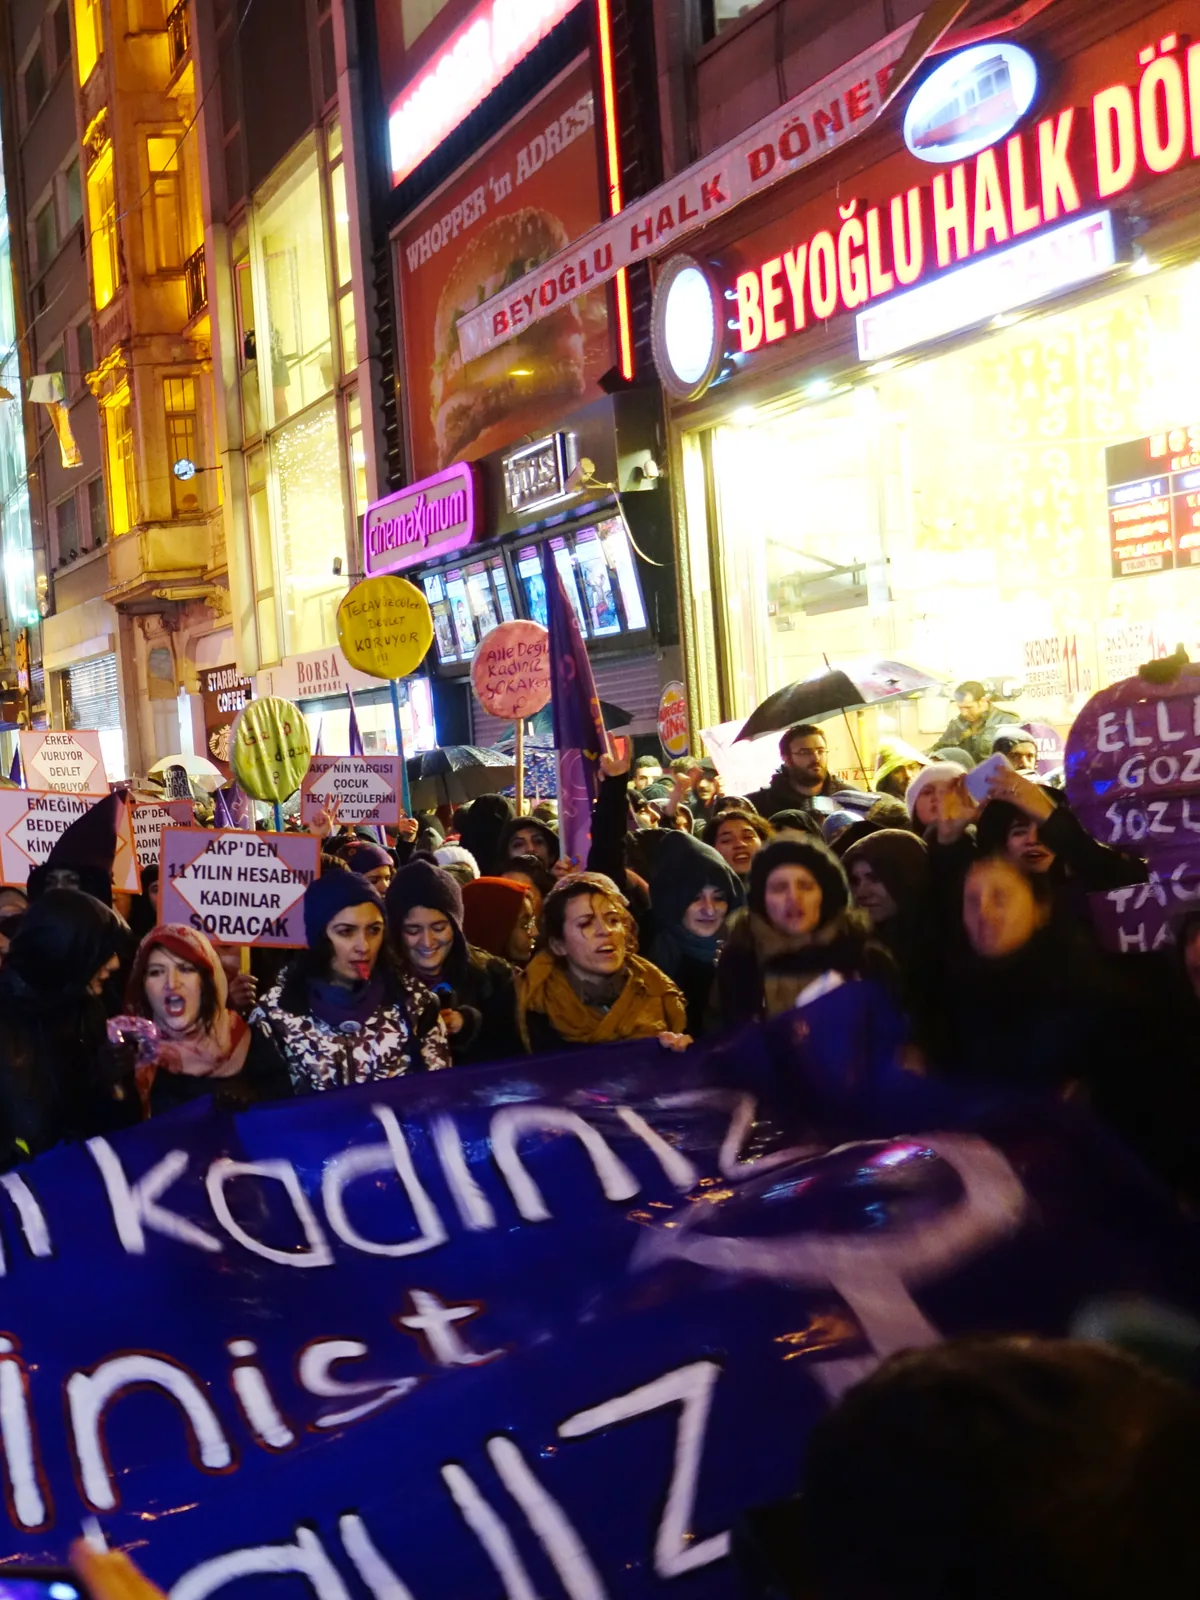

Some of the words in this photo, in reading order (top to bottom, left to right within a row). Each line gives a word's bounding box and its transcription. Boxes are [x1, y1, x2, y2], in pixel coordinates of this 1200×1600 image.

[736, 186, 925, 354] BEYOĞLU
[932, 107, 1081, 269] HALK
[1093, 33, 1200, 198] DÖ
[406, 186, 487, 273] WHOPPER
[493, 242, 613, 337] BEYOĞLU
[630, 173, 731, 252] HALK
[354, 631, 419, 652] KORUYOR
[517, 640, 549, 658] Deği
[296, 654, 340, 684] BORSA
[217, 689, 246, 713] COFFEE
[44, 735, 75, 746] ERKEK
[40, 751, 84, 762] VURUYOR
[49, 766, 81, 777] DEVLET
[353, 763, 393, 774] YARGISI
[333, 778, 369, 791] ÇOCUK
[26, 796, 98, 814] EMEĞİMİ
[305, 791, 397, 804] TECVÜZCÜLERİNİ
[26, 818, 76, 833] BEDEN
[133, 824, 147, 835] LIN
[26, 836, 57, 854] KİM
[136, 838, 161, 849] ADIN
[205, 840, 278, 858] AKP'DEN
[168, 863, 188, 879] 11
[191, 864, 232, 881] YILIN
[237, 866, 315, 885] HESABINI
[200, 890, 281, 909] KADINLAR
[189, 913, 289, 938] SORACAK
